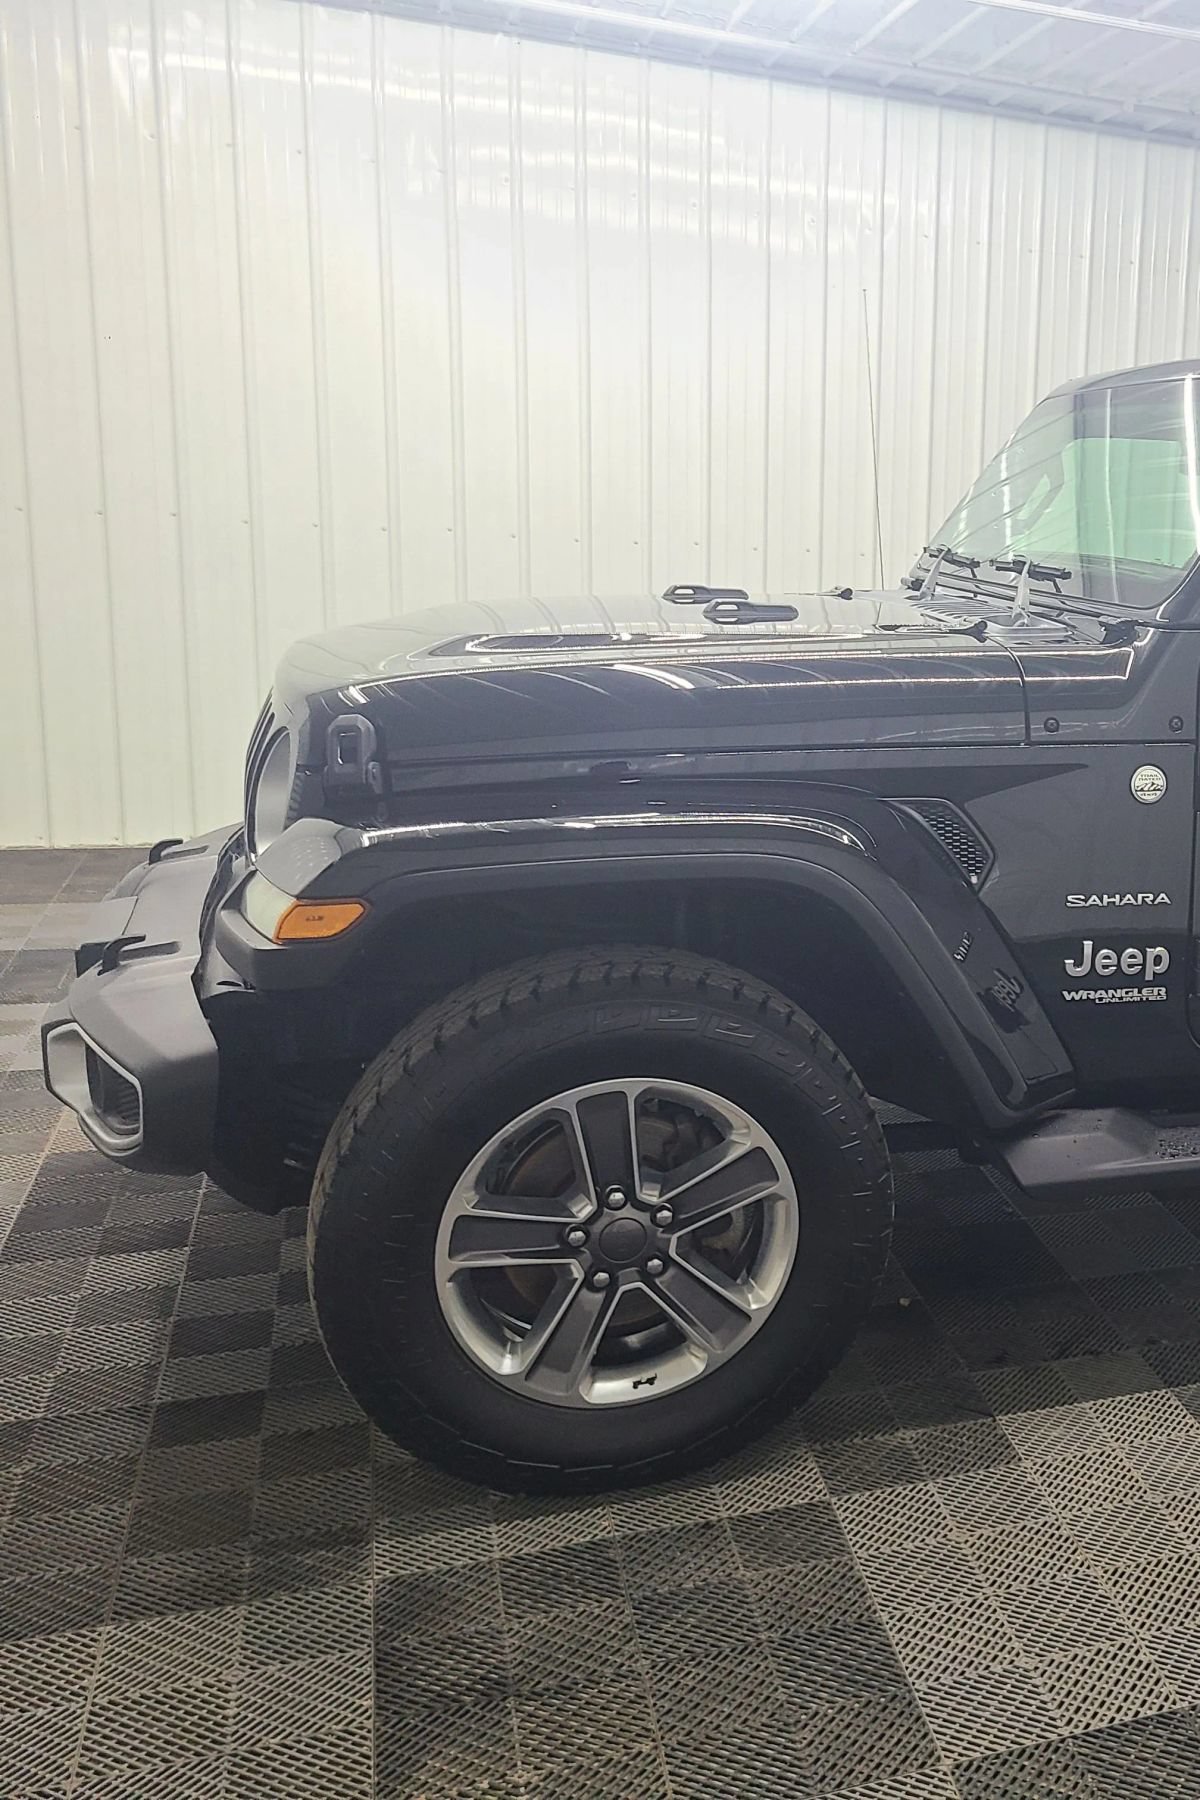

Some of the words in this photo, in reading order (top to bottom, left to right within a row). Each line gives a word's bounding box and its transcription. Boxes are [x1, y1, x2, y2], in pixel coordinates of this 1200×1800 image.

[1066, 892, 1171, 907] SAHARA
[1064, 940, 1170, 981] Jeep
[1062, 986, 1167, 1001] WRANGLER
[1095, 995, 1167, 1004] UNLIMITED
